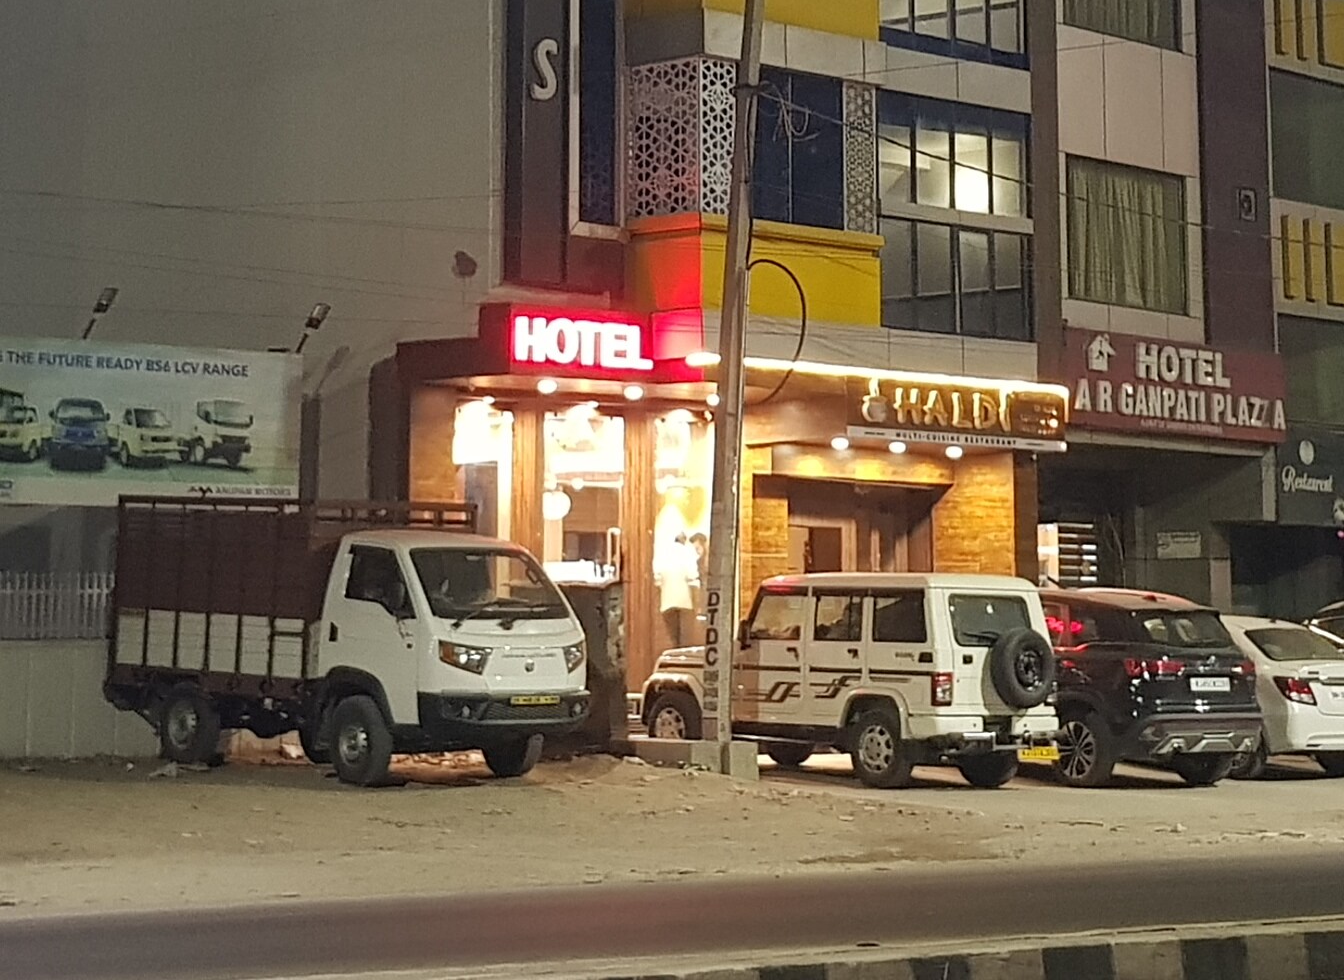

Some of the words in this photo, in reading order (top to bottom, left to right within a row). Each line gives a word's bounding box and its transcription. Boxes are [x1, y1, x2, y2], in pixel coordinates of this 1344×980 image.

[6, 350, 35, 365] THE
[38, 353, 93, 369] FUTURE
[96, 356, 144, 371] READY
[174, 359, 200, 374] LCV
[202, 362, 249, 378] RANGE
[514, 315, 654, 370] HOTEL
[1135, 342, 1231, 388] HOTEL
[893, 386, 1012, 432] HALDI
[1096, 380, 1113, 413] R
[1118, 381, 1206, 423] GANPATI
[964, 435, 1017, 447] RESTAURANT
[705, 591, 720, 666] DTDC
